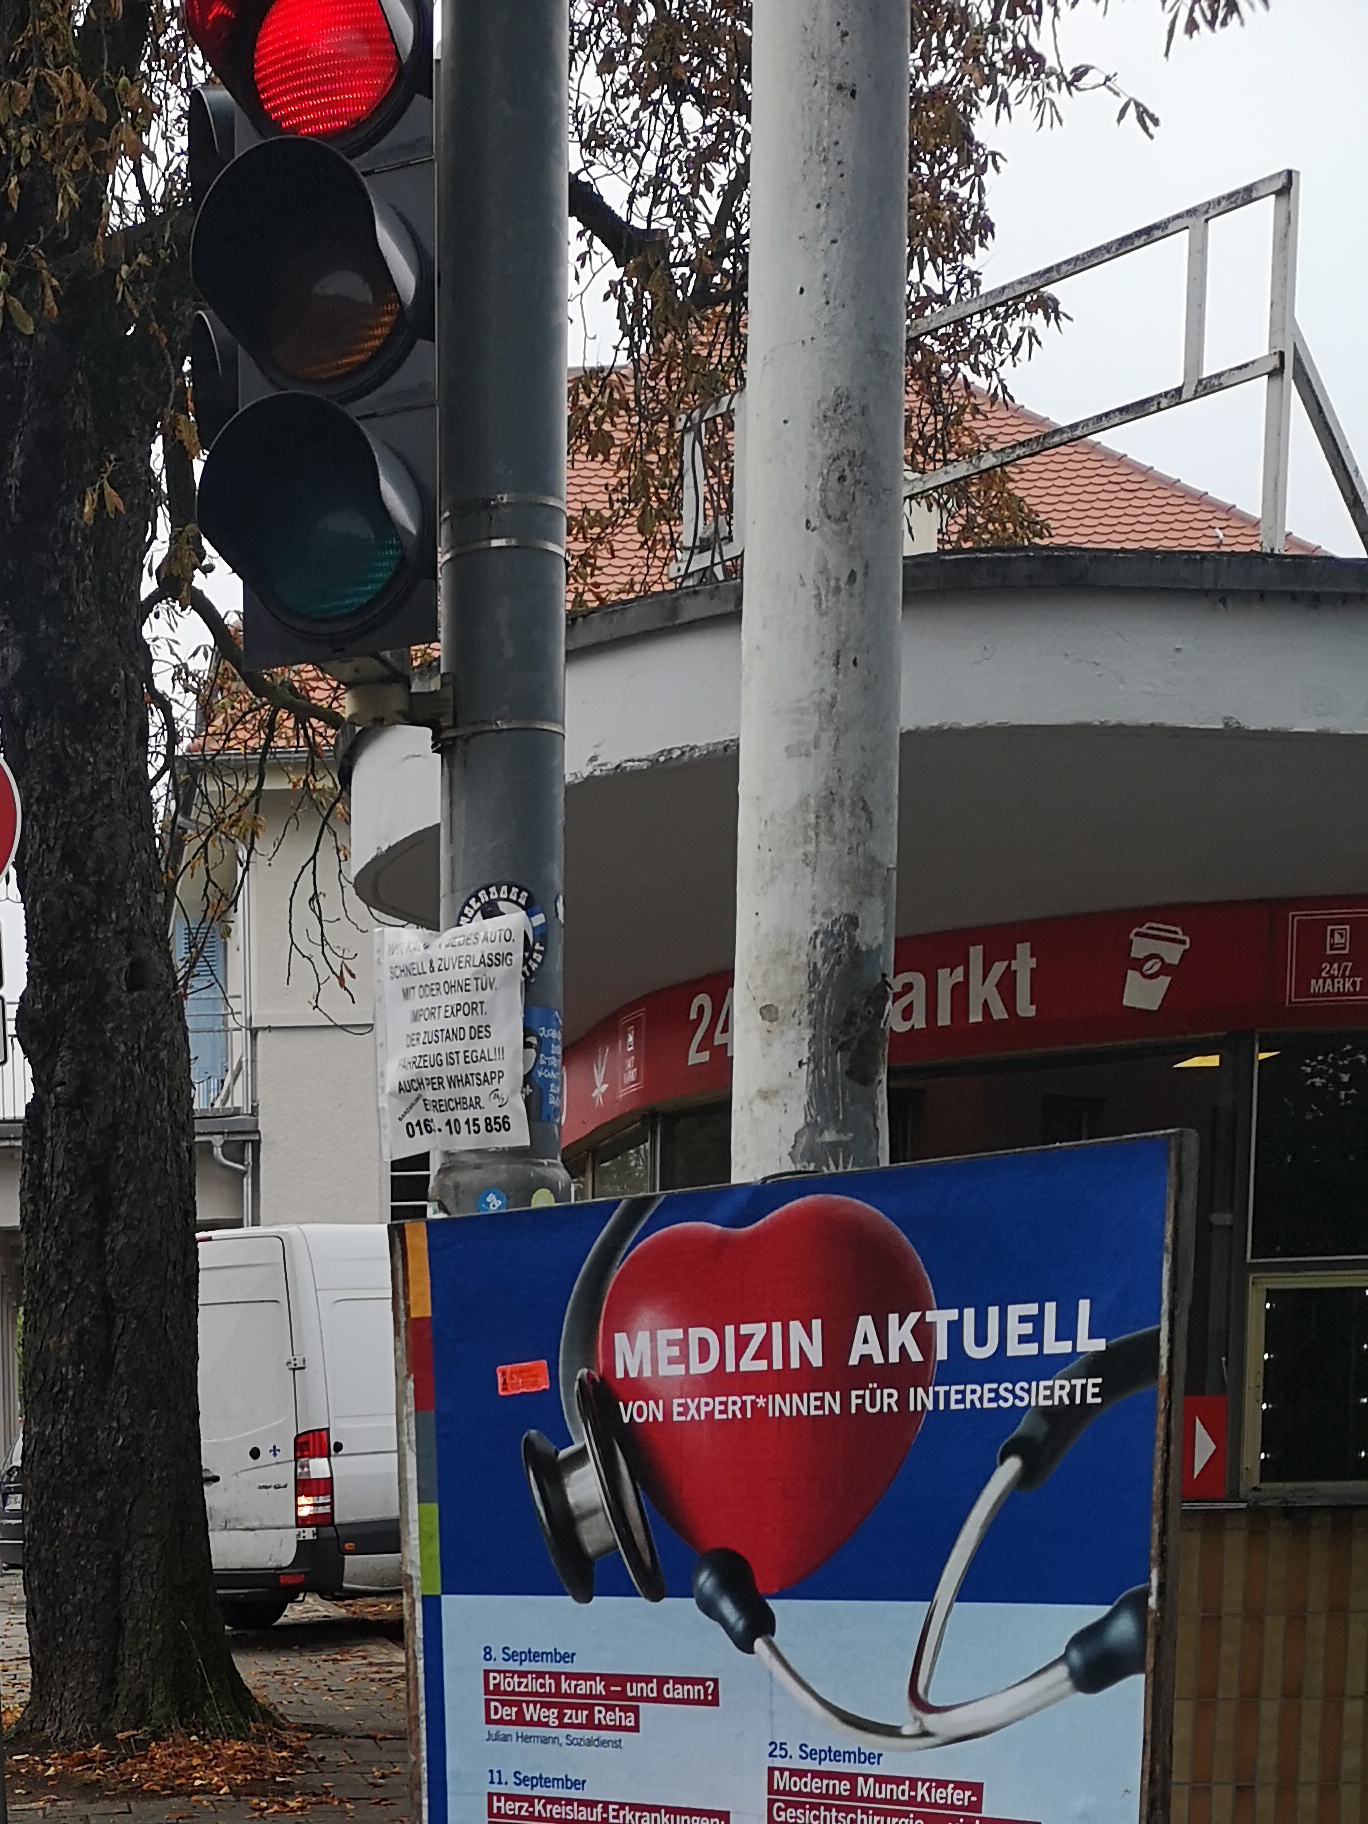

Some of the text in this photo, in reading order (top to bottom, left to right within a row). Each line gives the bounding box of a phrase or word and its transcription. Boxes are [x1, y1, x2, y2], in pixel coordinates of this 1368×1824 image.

[483, 928, 515, 943] AUTO.
[390, 961, 427, 979] SCHNELL
[430, 958, 434, 973] &
[438, 952, 513, 972] ZUVERLÄSSIG
[1321, 962, 1353, 977] 24/7
[418, 982, 441, 998] ODER
[443, 978, 471, 994] OHNE
[474, 974, 497, 991] TÜV.
[890, 943, 1036, 1032] arkt
[1310, 977, 1362, 993] MARKT
[444, 1001, 487, 1018] EXPORT.
[406, 1024, 491, 1048] DER ZUSTAND DES
[446, 1046, 504, 1066] IST EGAL!!!
[398, 1070, 504, 1094] AUCH PER WHATSAPP
[423, 1096, 484, 1113] EREICHBAR.
[484, 1115, 511, 1133] 856
[613, 1318, 822, 1379] MEDIZIN
[848, 1299, 1107, 1365] AKTUELL
[619, 1399, 666, 1423] VON
[849, 1385, 899, 1415] FÜR
[907, 1378, 1103, 1412] INTERESSIERTE
[483, 1645, 576, 1666] 8. September
[488, 1673, 714, 1700] Plötzlich krank und dann?
[490, 1702, 635, 1727] Der Weg zur Reha
[486, 1730, 623, 1749] Julian Hermann, Sozialdienst
[768, 1741, 883, 1766] 25. September
[488, 1769, 586, 1791] 11. September
[773, 1771, 977, 1806] Moderne Mund-Kiefer-
